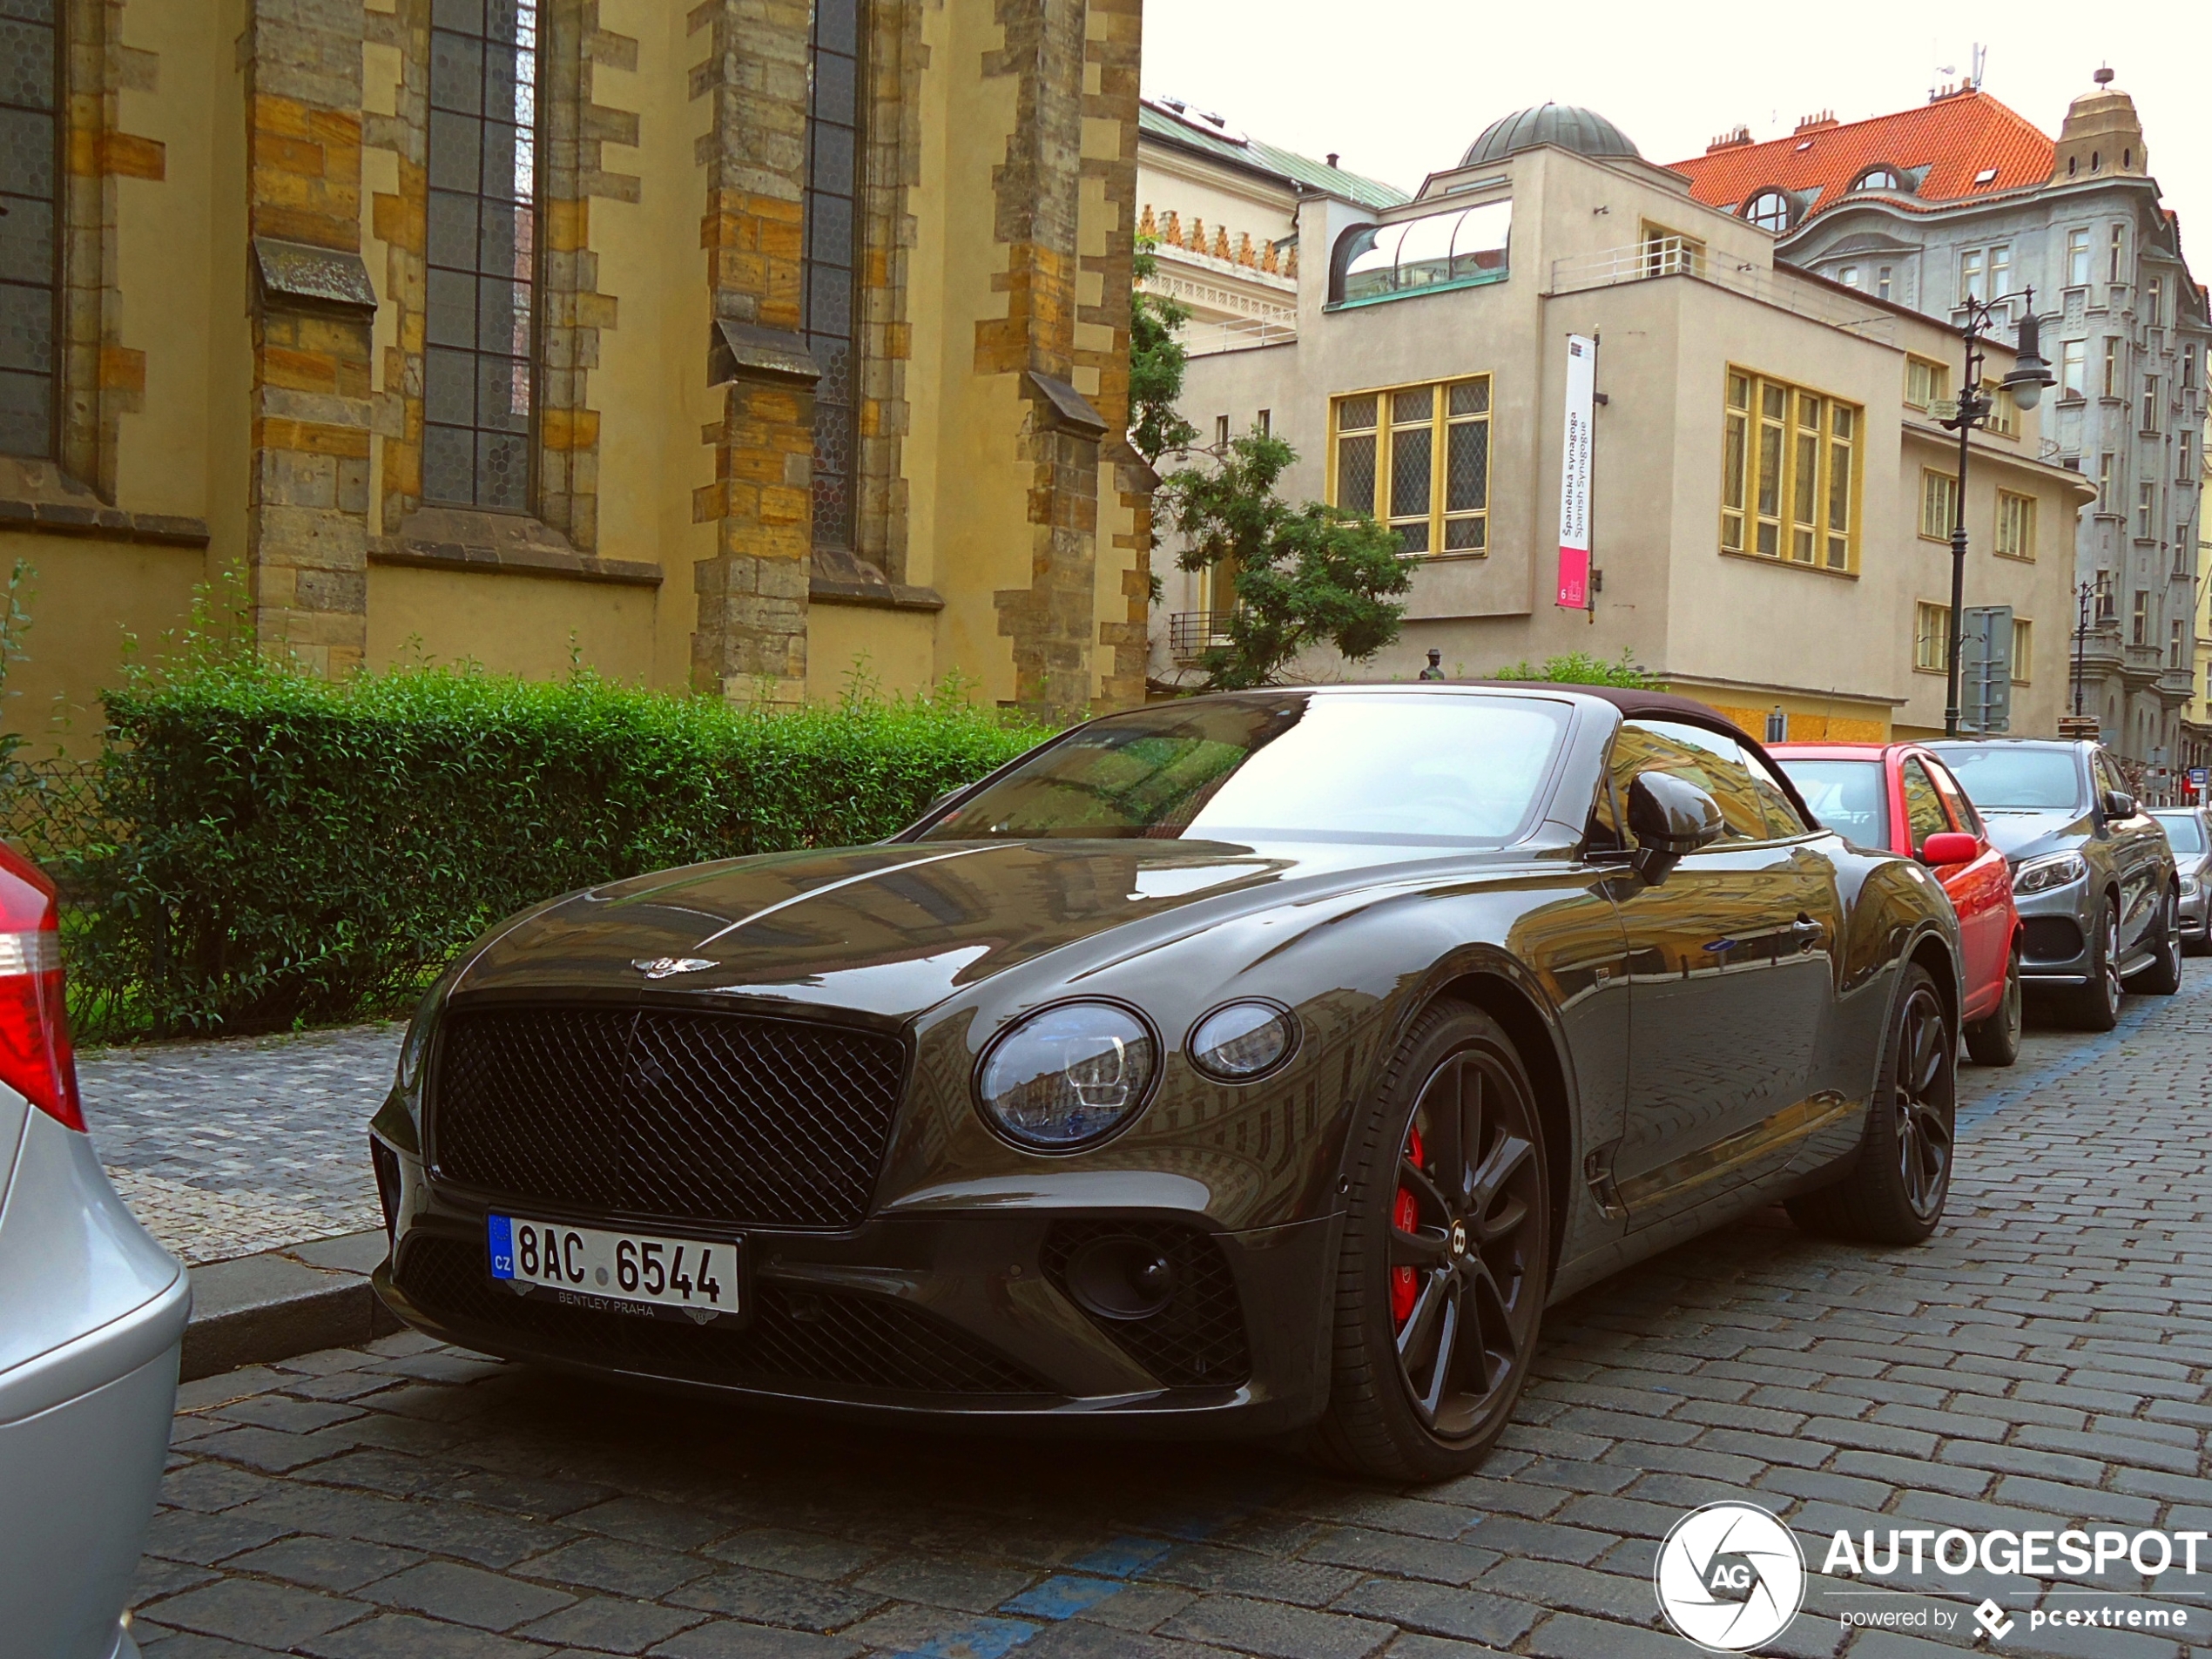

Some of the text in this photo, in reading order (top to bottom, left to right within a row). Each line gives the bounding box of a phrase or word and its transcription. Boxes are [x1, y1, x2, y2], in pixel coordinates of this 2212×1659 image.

[1562, 412, 1578, 536] Španělská synagoga
[1575, 421, 1588, 538] Spanish Synagogue
[1561, 589, 1567, 600] 6
[495, 1255, 511, 1271] CZ
[518, 1224, 720, 1303] 8AC 6544
[558, 1291, 655, 1317] BENTLEY PRAHA
